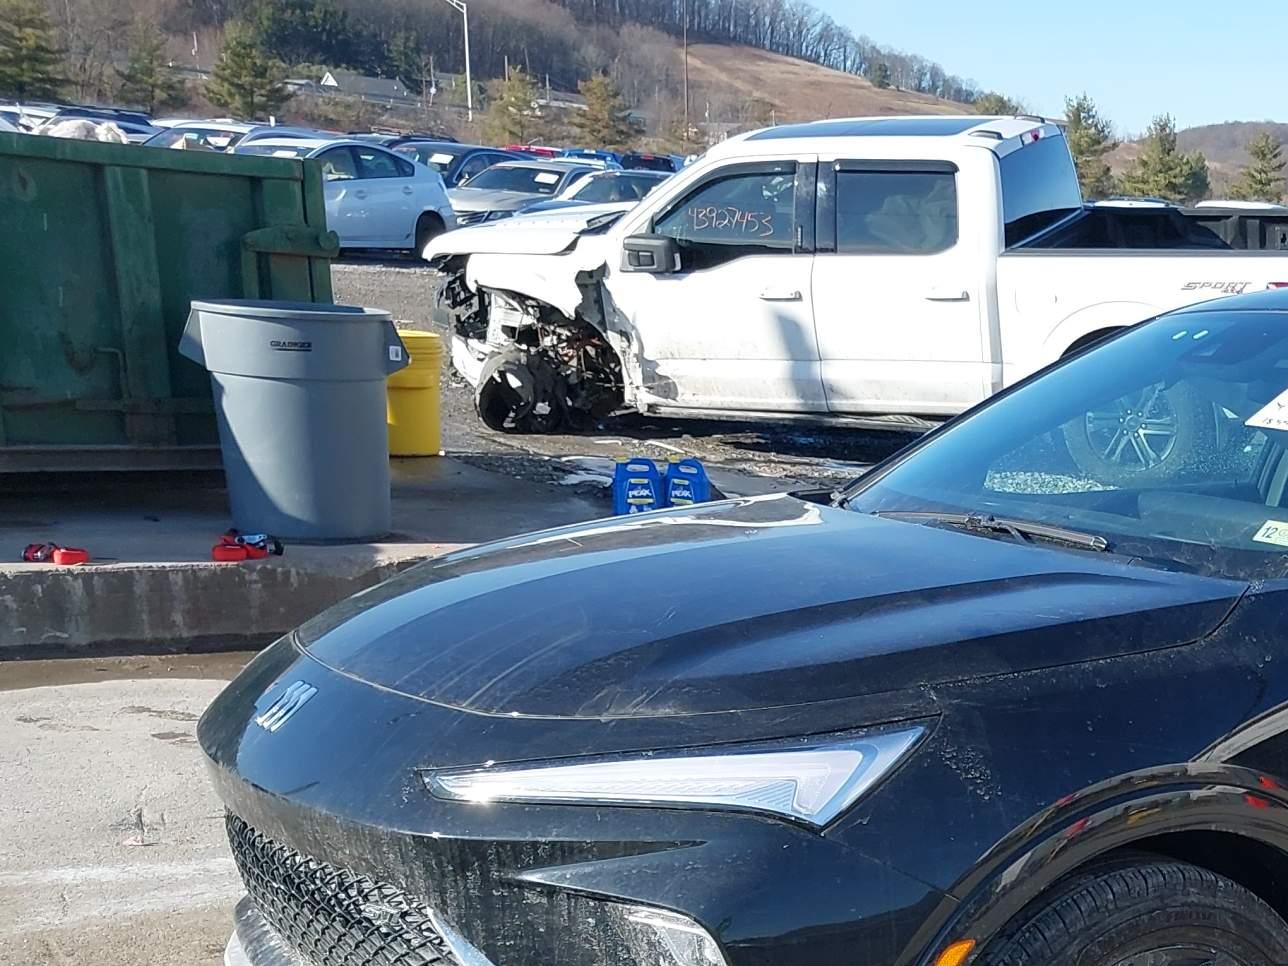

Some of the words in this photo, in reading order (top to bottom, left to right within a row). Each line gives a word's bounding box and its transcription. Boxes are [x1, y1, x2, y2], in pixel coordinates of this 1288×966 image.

[688, 206, 774, 237] 43927453
[1180, 281, 1253, 291] SPORT
[1260, 526, 1278, 539] 12
